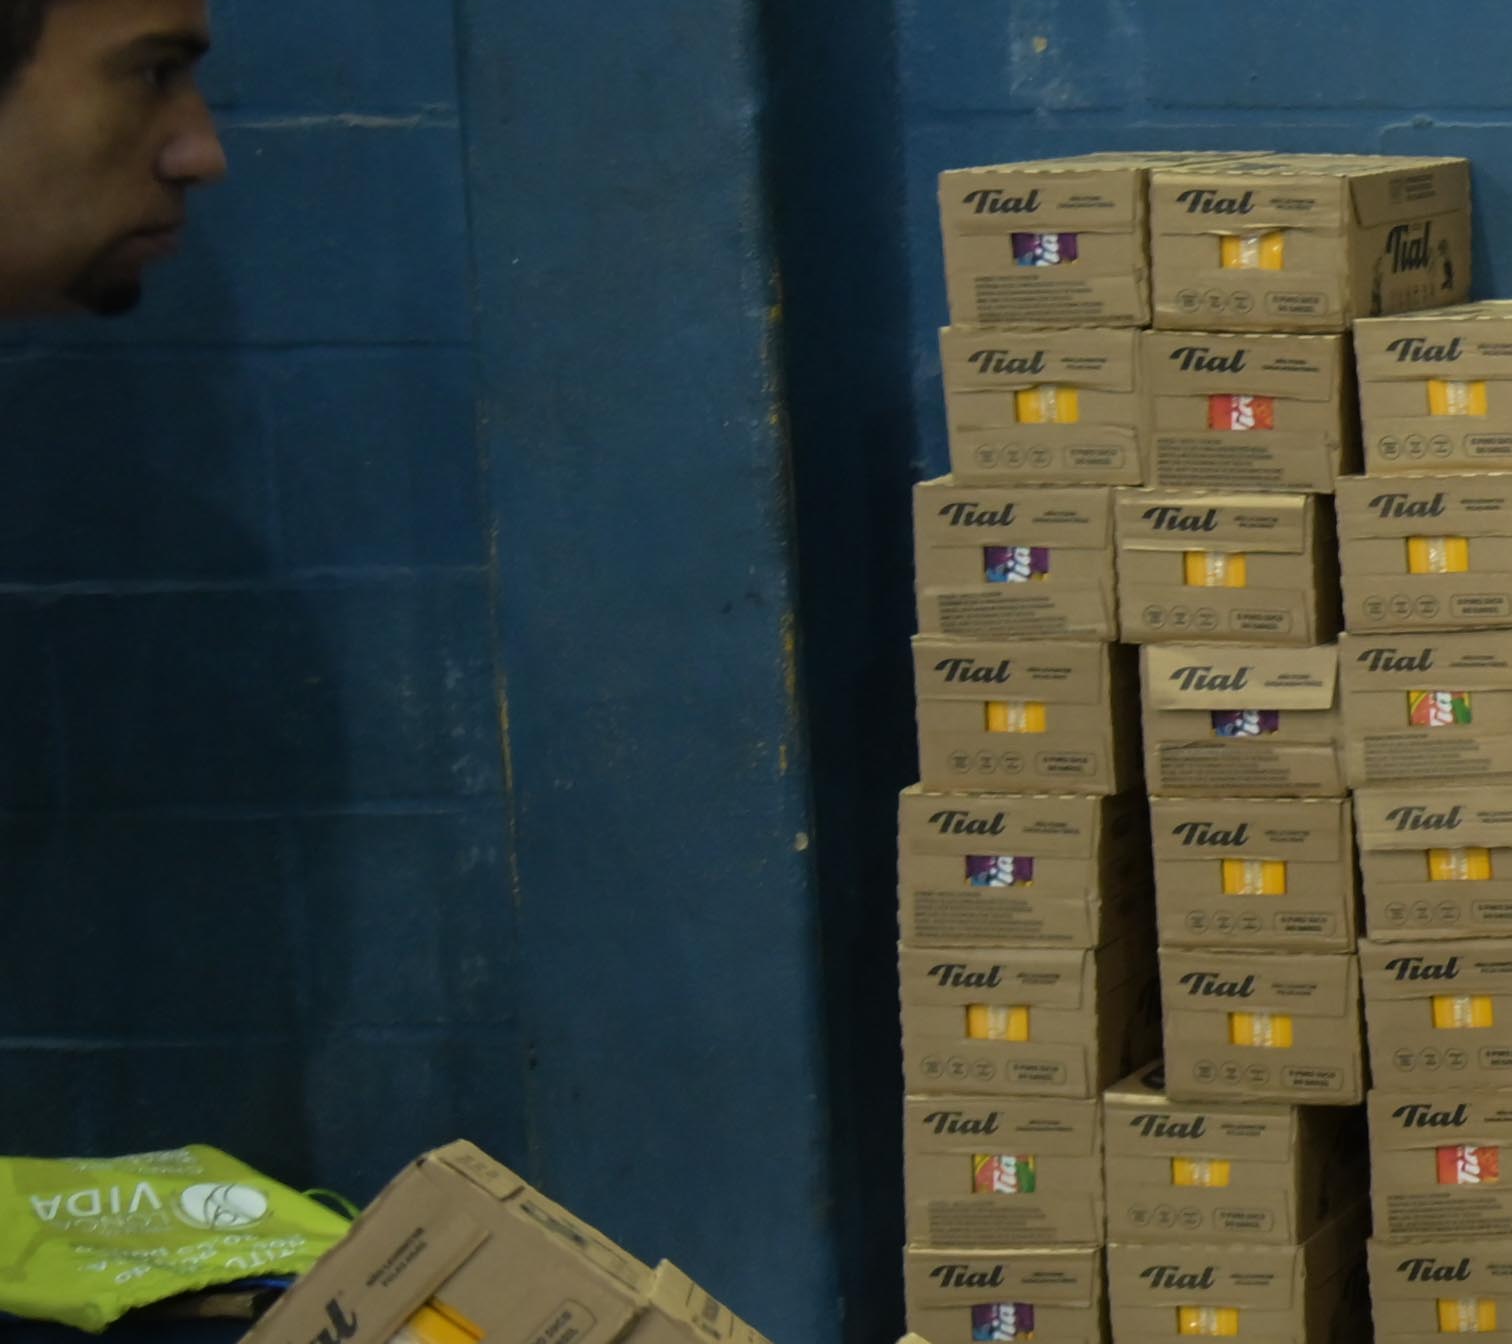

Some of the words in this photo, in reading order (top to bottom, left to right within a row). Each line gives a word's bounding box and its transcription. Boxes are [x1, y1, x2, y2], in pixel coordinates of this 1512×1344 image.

[963, 189, 1040, 213] Tial
[1176, 190, 1254, 214] Tial
[1170, 347, 1245, 373] Tial
[1386, 337, 1462, 362] Tial
[968, 350, 1045, 374] Tial
[939, 503, 1014, 526] Tial
[1369, 493, 1445, 518] Tial
[1142, 507, 1217, 531] Tial
[934, 659, 1010, 683] Tial
[1357, 648, 1432, 671] Tial
[1170, 667, 1248, 691] Tial
[928, 811, 1005, 835] Tial
[1386, 806, 1462, 830] Tial
[1172, 823, 1248, 846] Tial
[928, 964, 1001, 988] Tial
[1384, 957, 1459, 980] Tial
[923, 1112, 998, 1134] Tial
[1130, 1115, 1205, 1138] Tial
[1392, 1104, 1467, 1127] Tial
[30, 1182, 162, 1221] VIDA
[930, 1265, 1004, 1287] Tial
[1140, 1266, 1214, 1289] Tial
[1397, 1258, 1471, 1281] Tial
